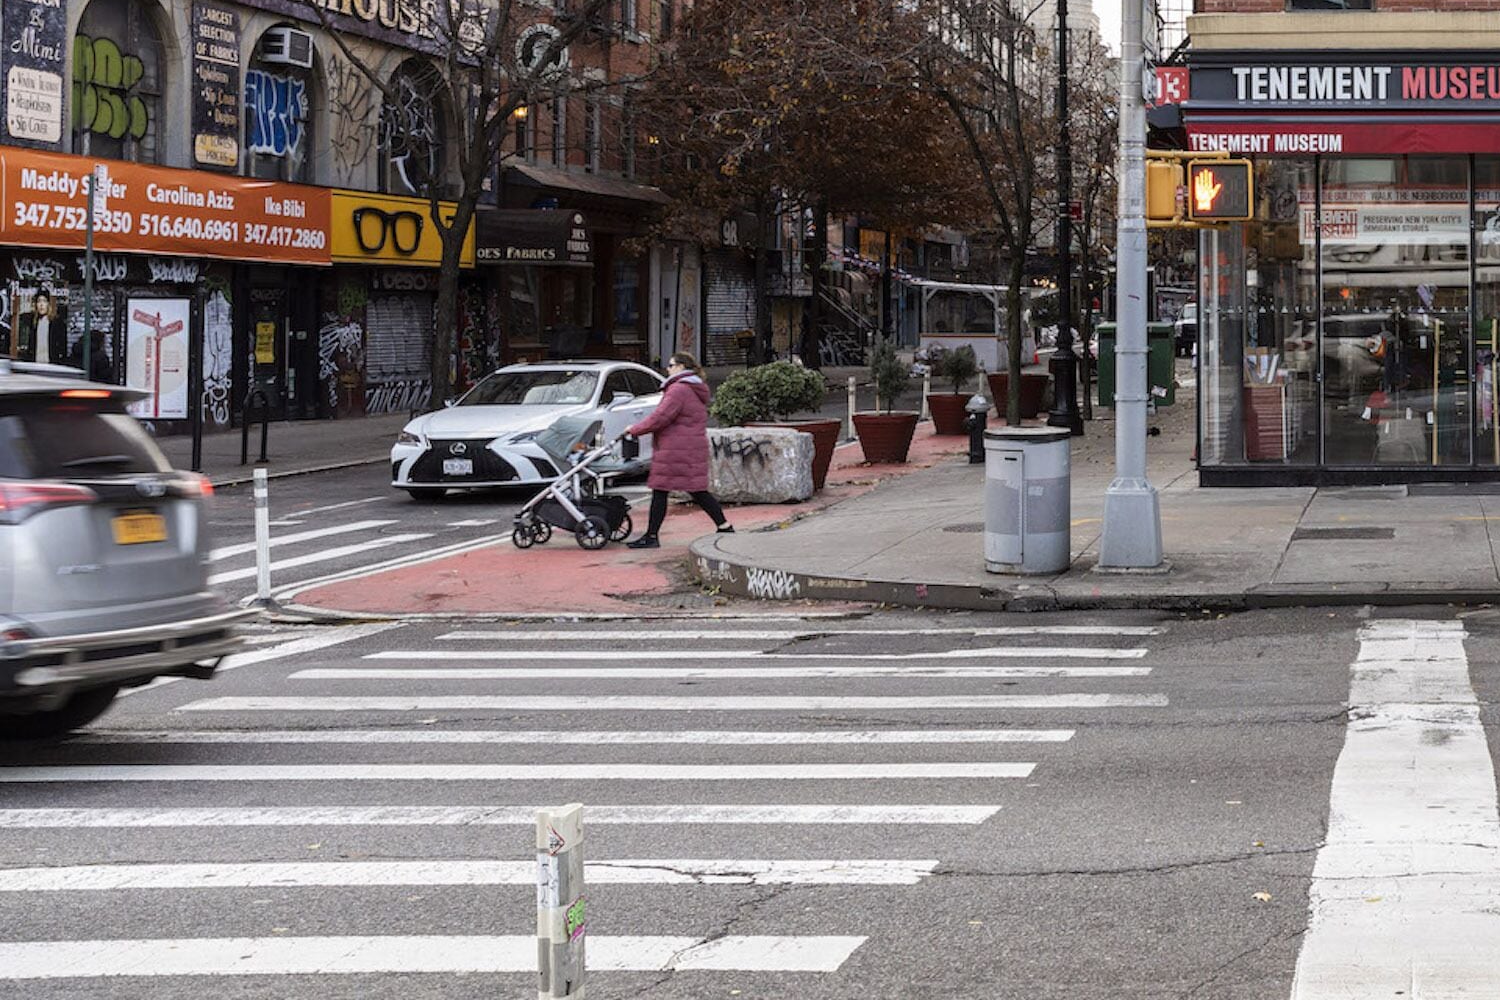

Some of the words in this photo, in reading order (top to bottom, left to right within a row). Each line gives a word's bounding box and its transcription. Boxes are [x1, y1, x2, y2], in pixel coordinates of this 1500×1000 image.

[202, 7, 233, 25] LARGEST
[199, 25, 235, 41] SELECTION
[196, 42, 206, 55] OF
[210, 43, 238, 62] FABRICS
[1232, 67, 1391, 99] TENEMENT
[1190, 133, 1270, 153] TENEMENT
[1274, 134, 1342, 152] MUSEUM
[21, 168, 78, 199] Maddy
[146, 183, 204, 207] Carolina
[207, 190, 235, 211] Aziz
[265, 197, 281, 216] Ike
[283, 199, 305, 218] Bibi
[1371, 191, 1393, 201] WALK
[14, 202, 132, 235] 347.7525350
[139, 213, 239, 243] 516.640.6961
[244, 223, 326, 250] 347.417.2860
[1363, 215, 1403, 224] PRESERVING
[1405, 215, 1420, 224] NEW
[1422, 215, 1439, 224] YORK
[722, 220, 738, 246] 98
[506, 246, 555, 259] FABRICS
